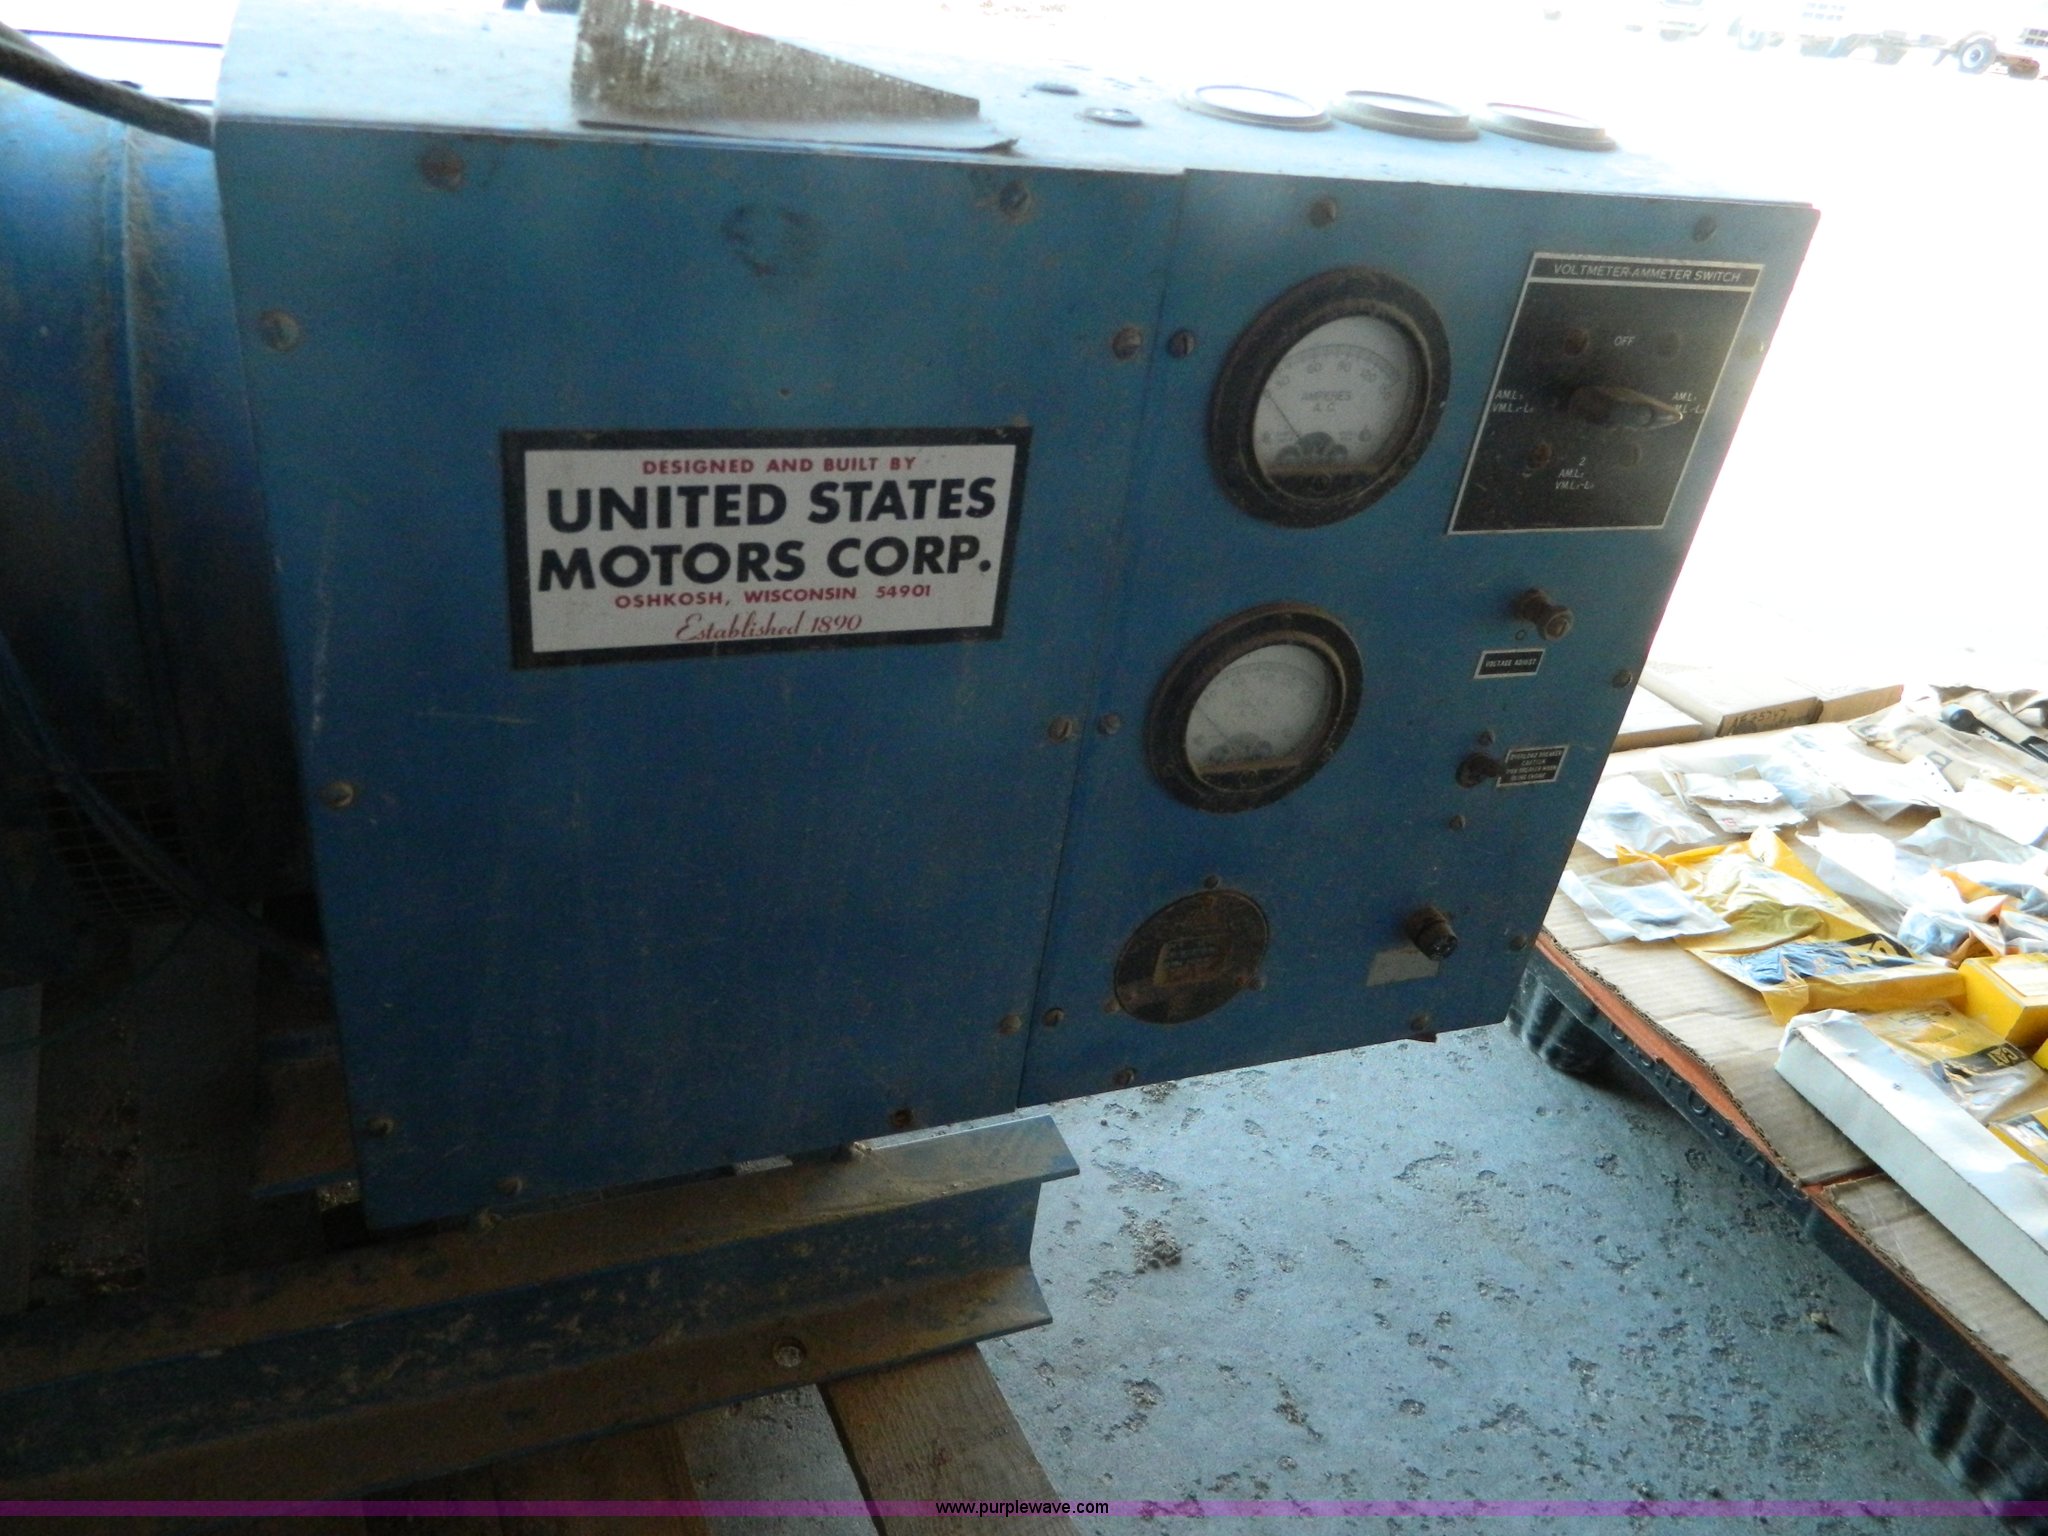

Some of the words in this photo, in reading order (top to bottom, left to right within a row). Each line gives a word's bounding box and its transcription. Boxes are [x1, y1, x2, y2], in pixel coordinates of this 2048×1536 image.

[1693, 270, 1741, 283] SWITCH
[1614, 335, 1636, 347] OFF
[642, 457, 754, 475] DESIGNED
[765, 456, 813, 473] AND
[823, 456, 879, 472] BUILT
[890, 455, 916, 471] BY
[546, 482, 787, 533] UNITED
[807, 475, 998, 524] STATES
[537, 539, 806, 592] MOTORS
[826, 534, 992, 579] CORP.
[614, 591, 731, 609] OSHKOSH,
[743, 586, 857, 604] WISCONSIN
[875, 583, 932, 599] 54901
[675, 611, 803, 643] Established
[808, 614, 863, 634] 1890
[1986, 1046, 2020, 1068] CAT
